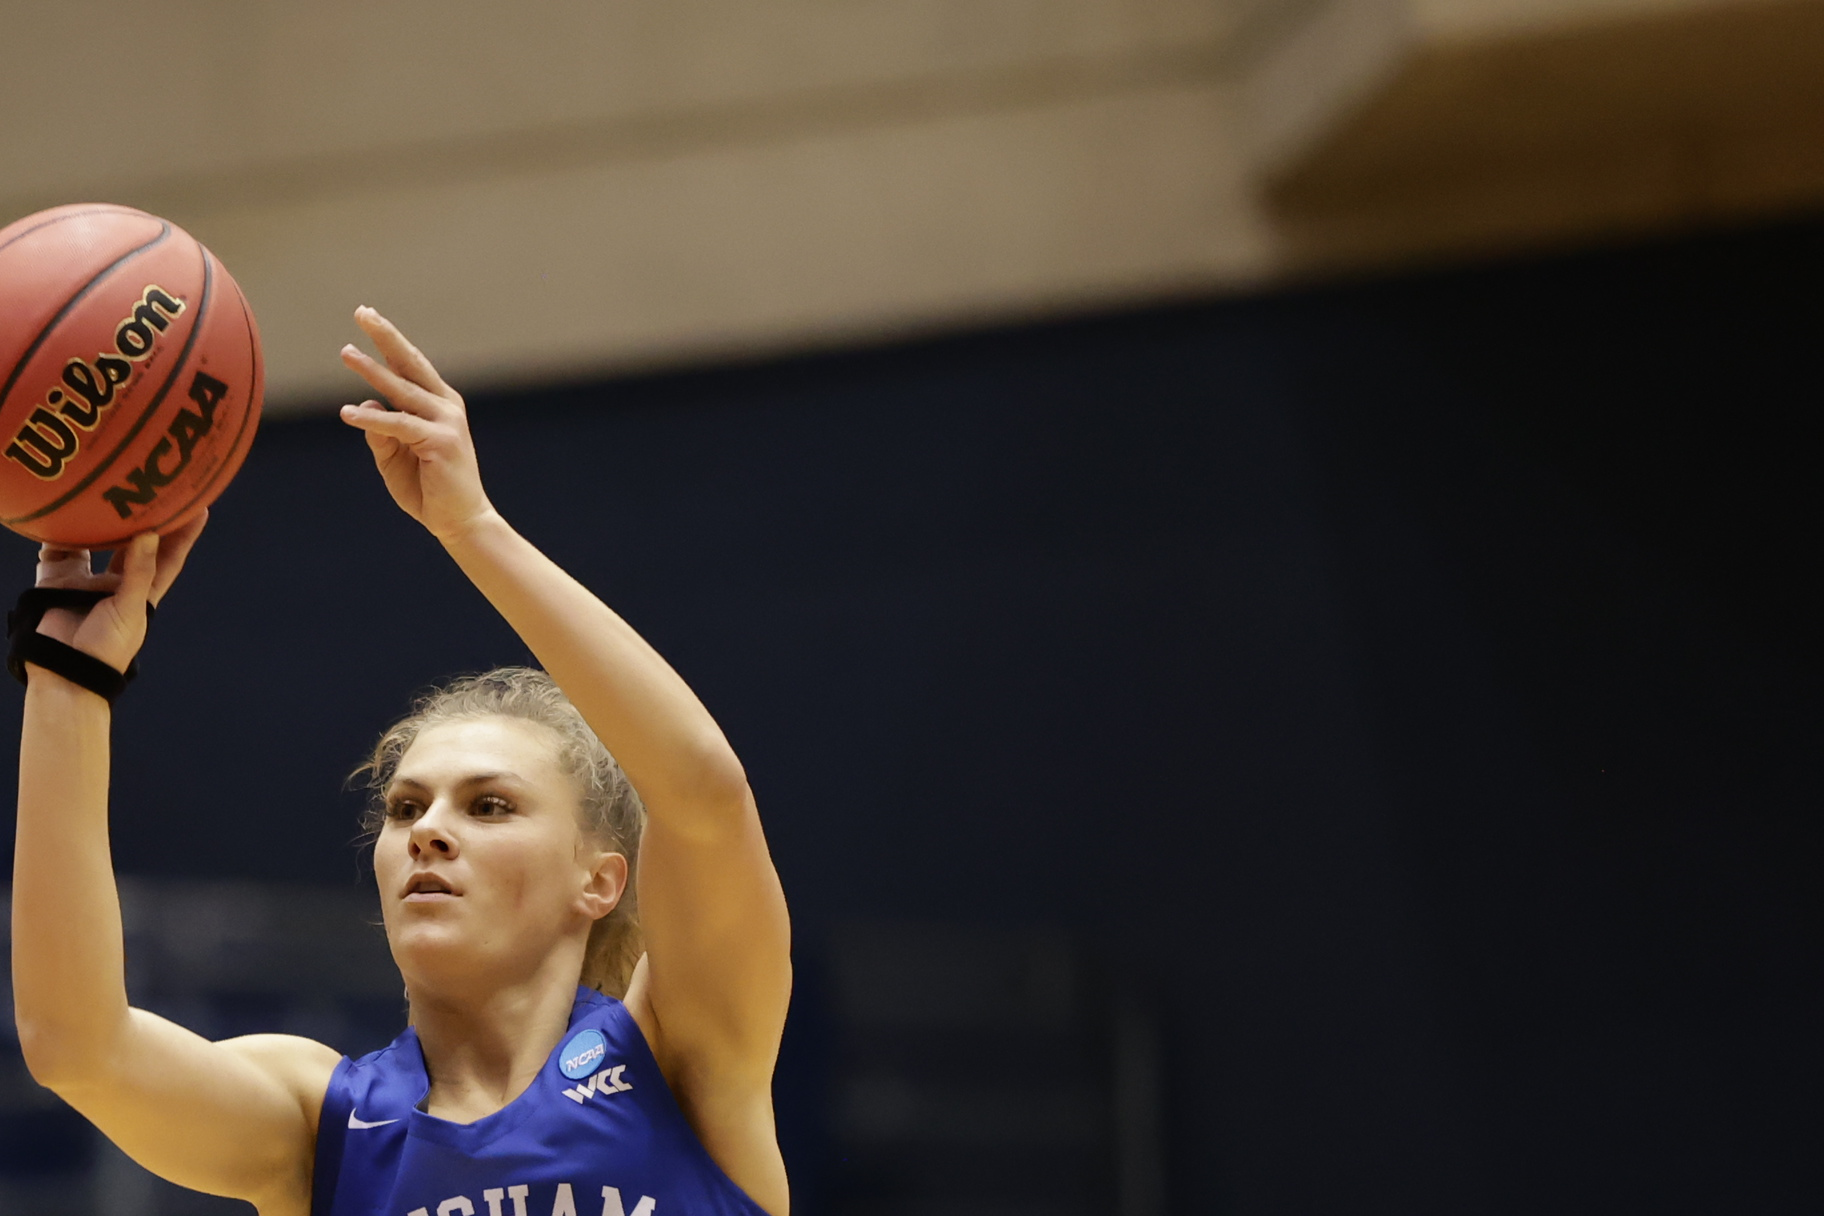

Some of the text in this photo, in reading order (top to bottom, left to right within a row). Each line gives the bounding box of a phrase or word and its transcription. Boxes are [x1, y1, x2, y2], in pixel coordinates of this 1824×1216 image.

[1, 284, 186, 482] Wilson
[102, 371, 229, 520] NCAA
[561, 1064, 633, 1105] WCC
[565, 1043, 605, 1073] NCAA
